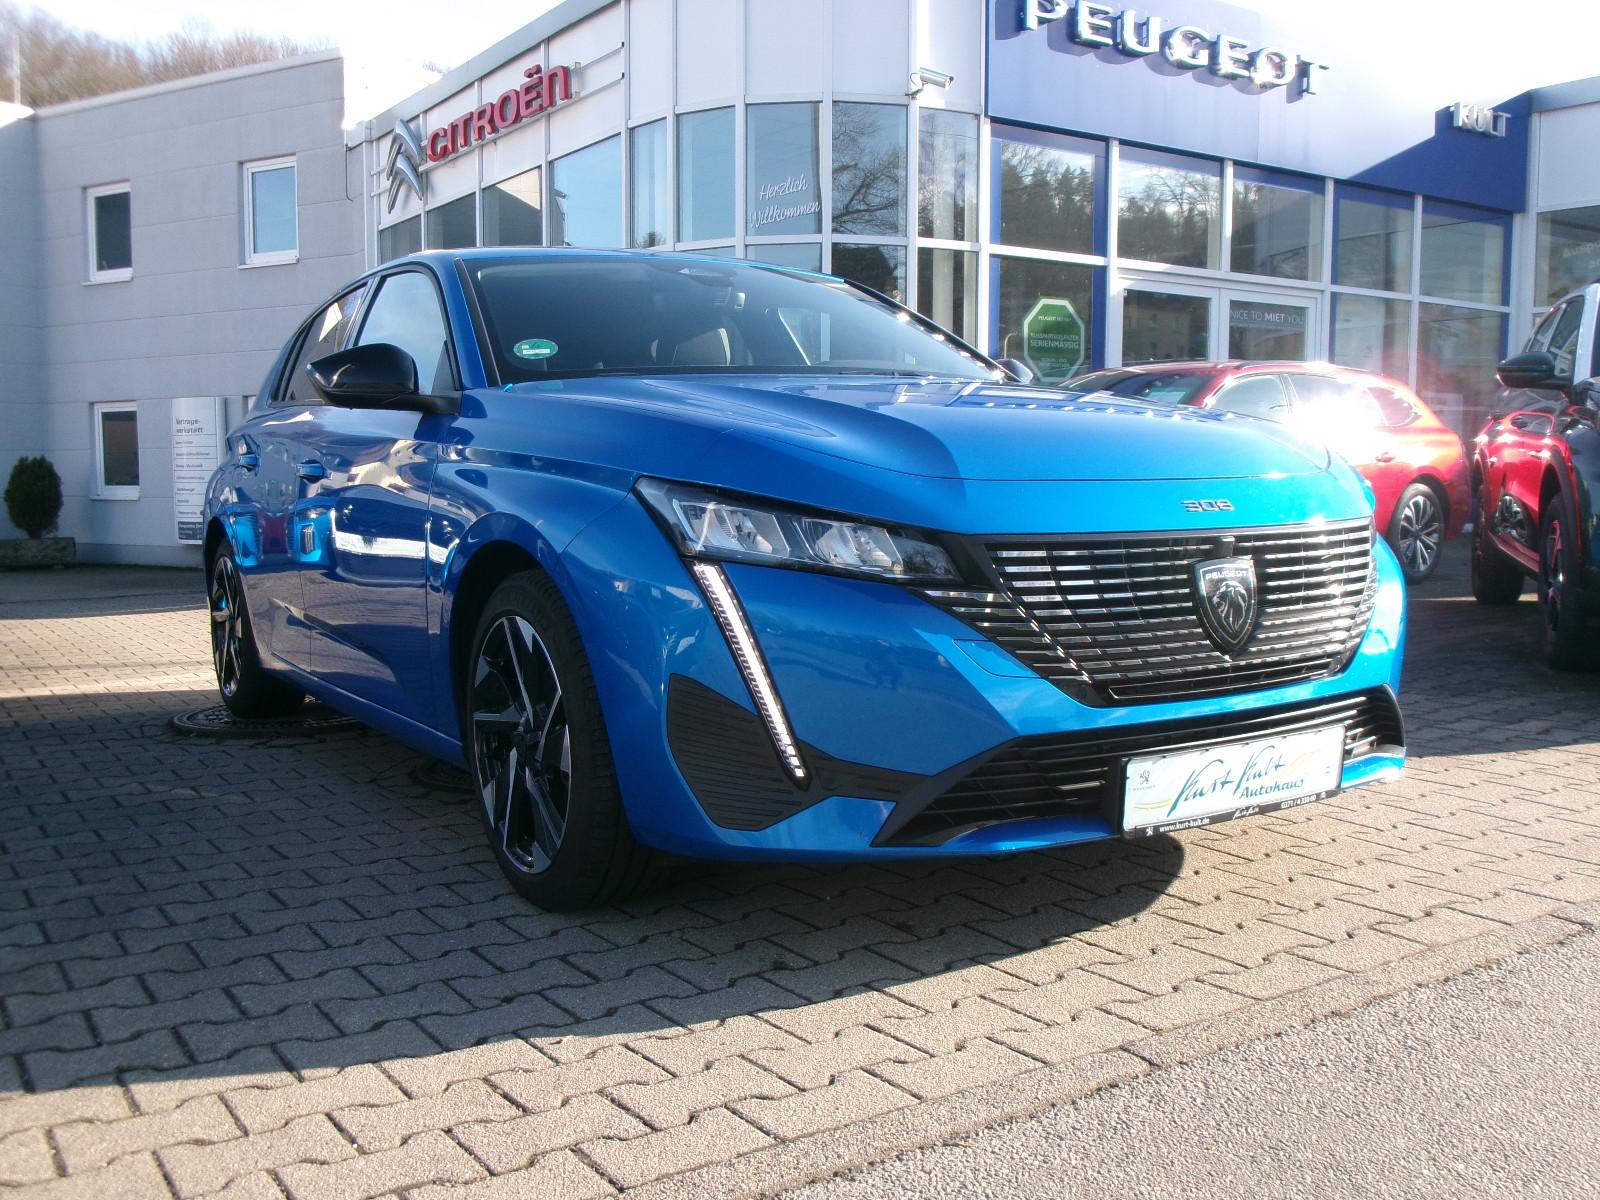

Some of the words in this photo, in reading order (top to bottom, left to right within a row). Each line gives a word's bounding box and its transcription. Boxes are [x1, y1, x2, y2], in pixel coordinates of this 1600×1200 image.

[1023, 0, 1329, 95] PEUGEOT
[760, 173, 809, 200] Herzlich
[749, 201, 820, 228] Willkommen
[1230, 310, 1248, 320] NICE
[1252, 311, 1263, 321] TO
[1264, 312, 1286, 322] MIET
[1181, 500, 1235, 512] 308
[1205, 570, 1248, 580] PEUGEOT
[1239, 778, 1305, 800] Autohaus
[1159, 817, 1210, 833] www.kurt-kult.de
